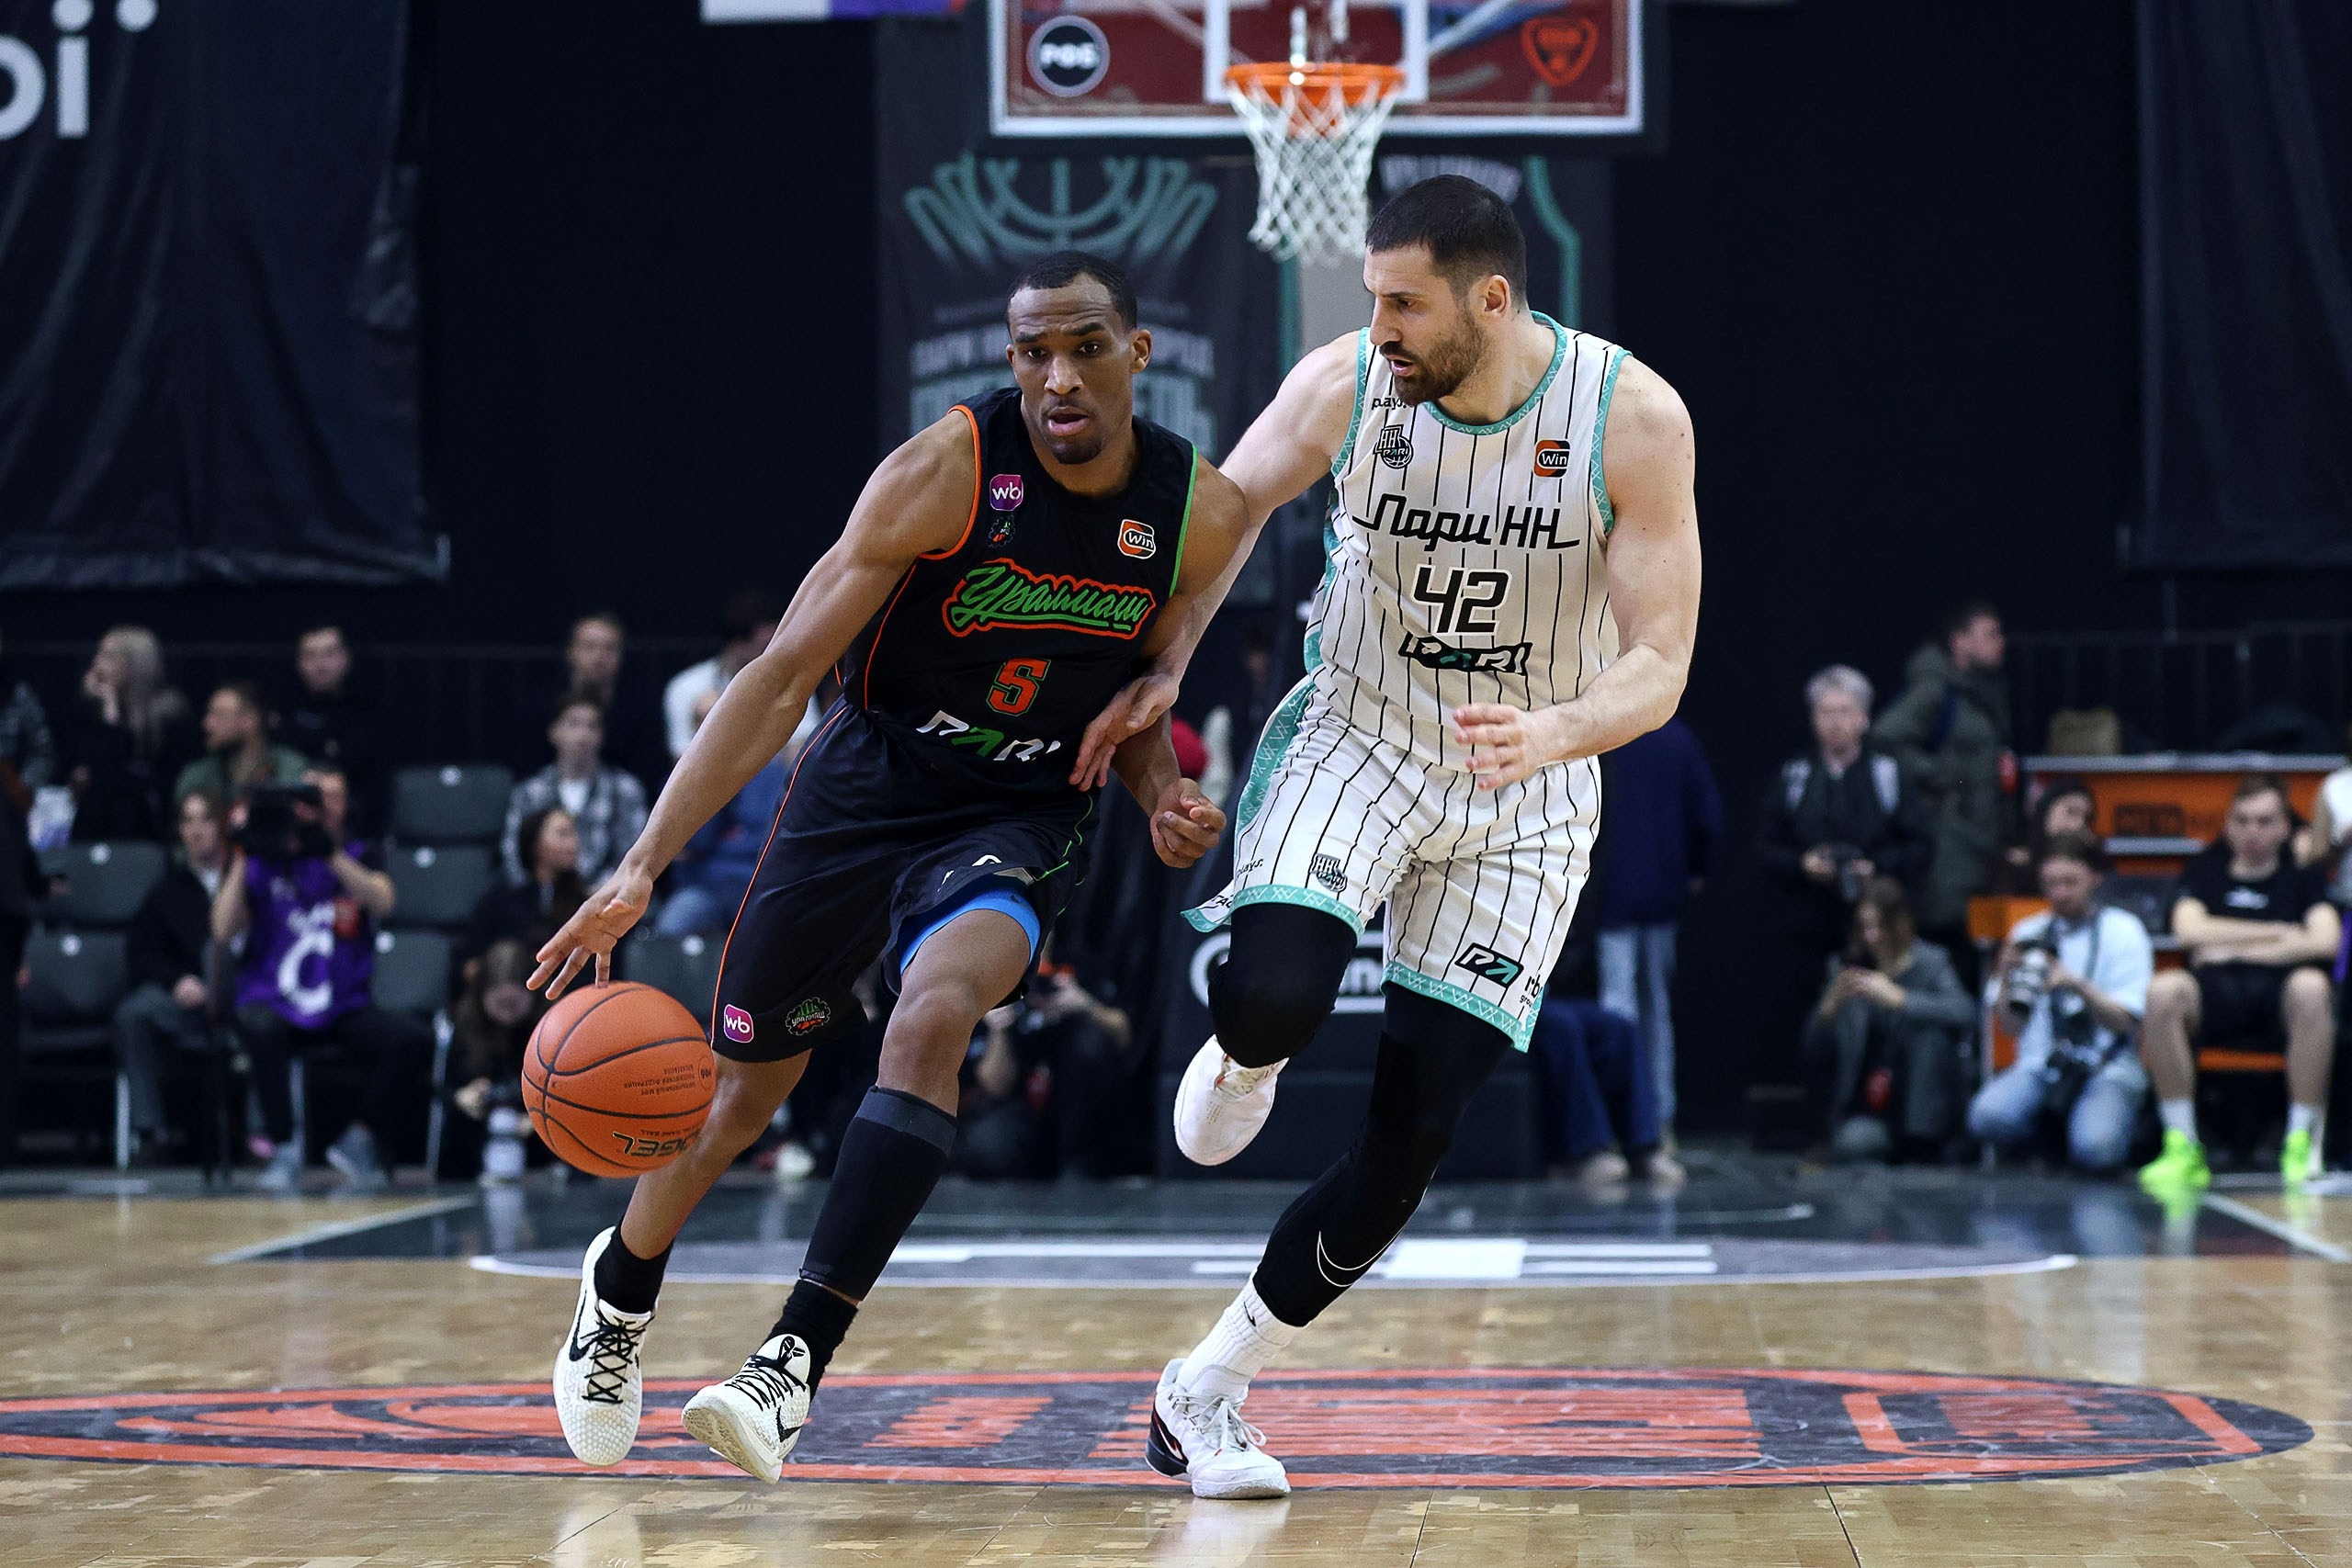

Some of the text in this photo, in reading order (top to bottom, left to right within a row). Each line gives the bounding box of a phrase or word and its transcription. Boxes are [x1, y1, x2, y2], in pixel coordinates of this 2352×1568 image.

[1542, 452, 1567, 466] Win
[992, 481, 1021, 501] wb
[1128, 532, 1154, 548] Win
[1412, 564, 1512, 636] 42
[725, 1014, 751, 1034] wb
